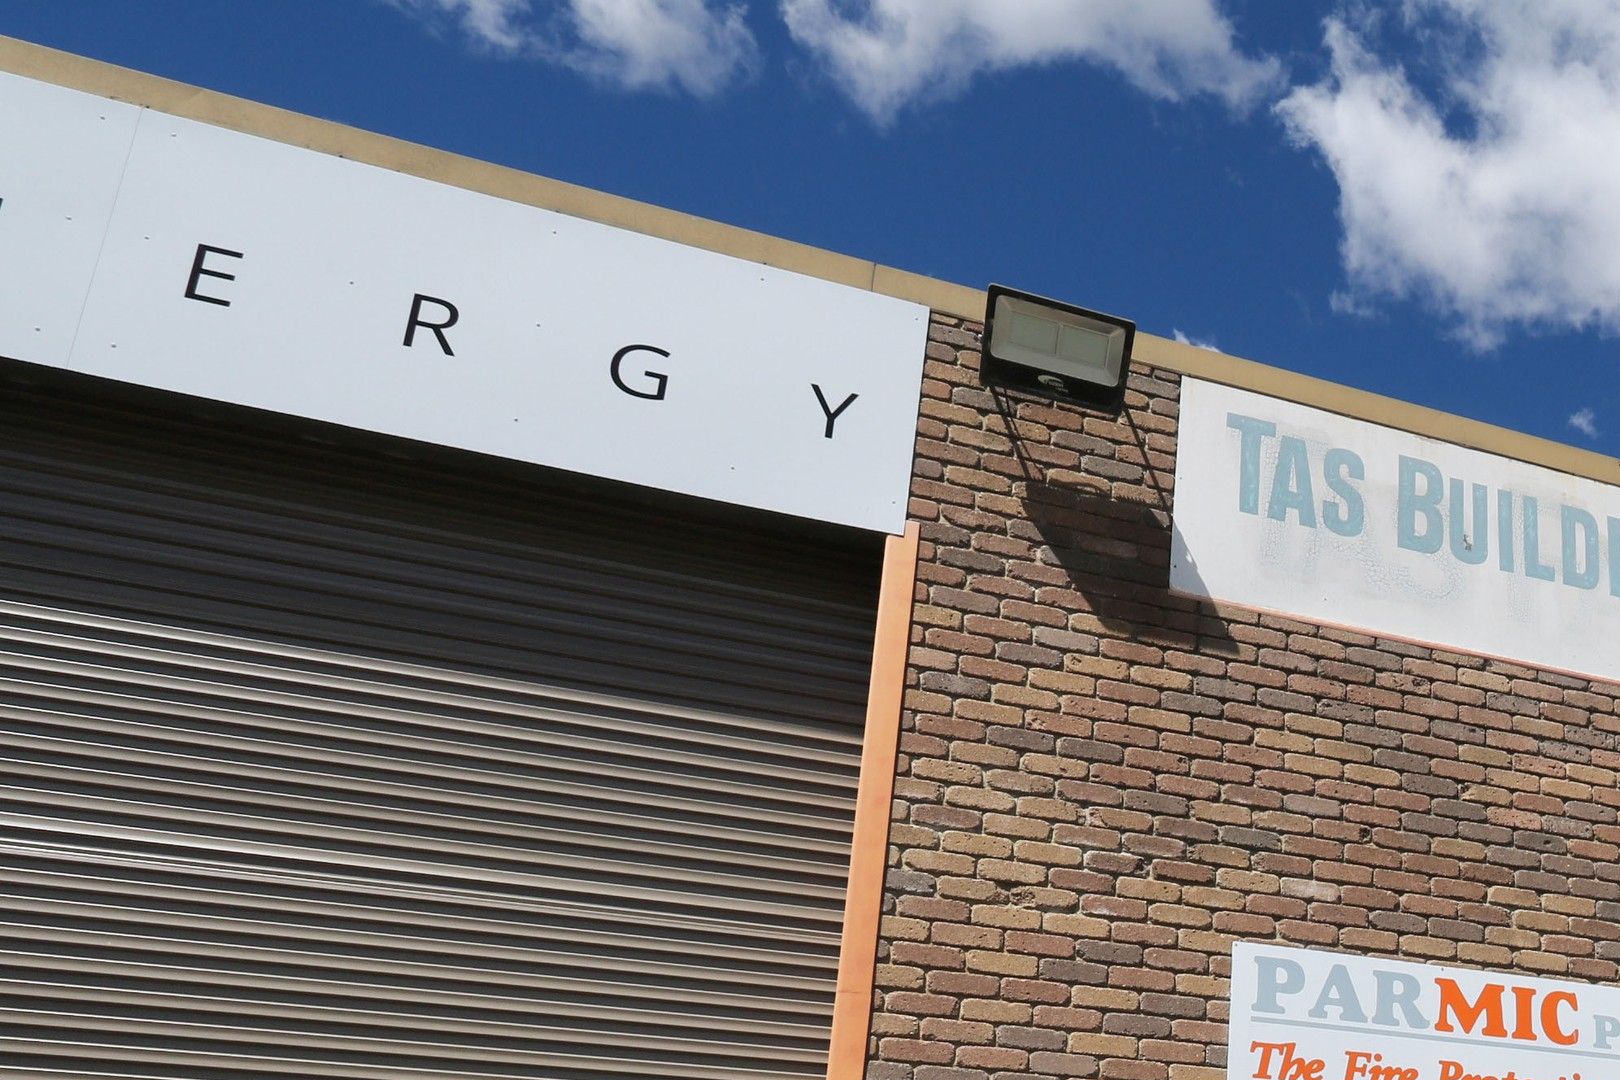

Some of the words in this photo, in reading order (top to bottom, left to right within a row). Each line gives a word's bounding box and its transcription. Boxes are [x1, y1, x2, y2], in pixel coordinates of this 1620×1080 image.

[0, 197, 859, 439] ERGY
[1226, 412, 1365, 537] TAS
[1250, 955, 1580, 1045] PARMIC
